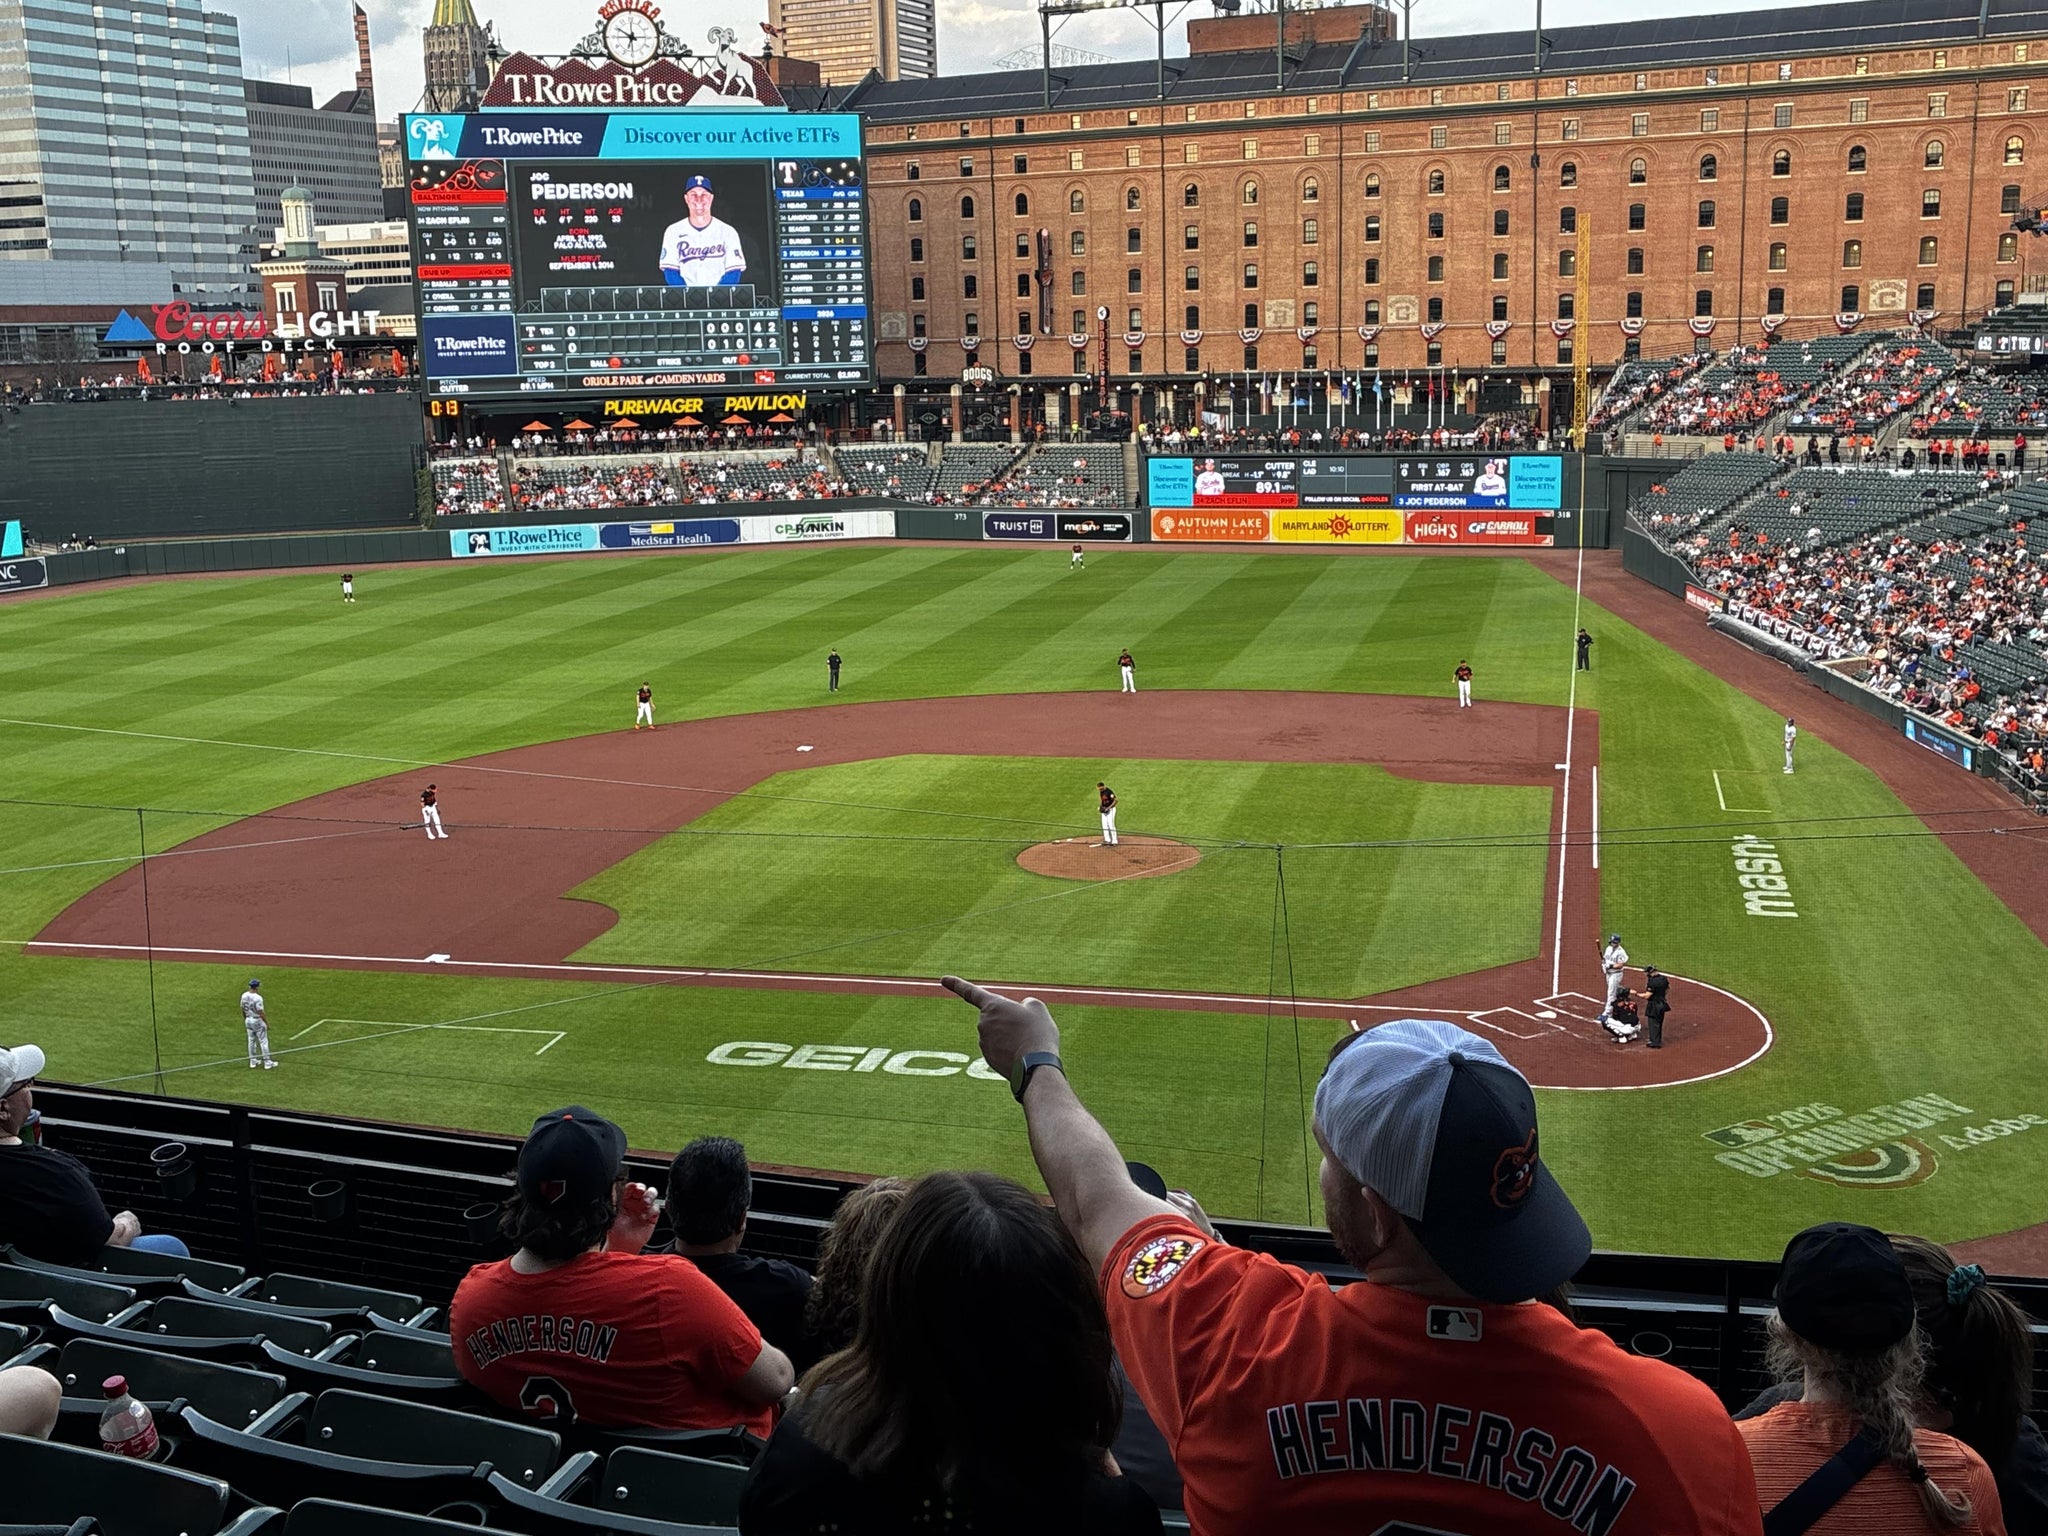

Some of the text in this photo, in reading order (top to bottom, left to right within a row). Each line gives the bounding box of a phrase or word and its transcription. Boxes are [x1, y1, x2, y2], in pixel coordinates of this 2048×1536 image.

[624, 126, 840, 144] Discover our Active ETFs
[530, 172, 550, 182] JOC
[417, 193, 462, 201] BALTIMORE
[531, 183, 633, 200] PEDERSON
[781, 190, 805, 198] TEXAS
[151, 300, 381, 341] Coors LIGHT
[156, 338, 337, 355] ROOF DECK
[582, 373, 726, 387] ORIOLE PARK CAMDEN YARDS
[431, 400, 459, 417] 0:13
[604, 394, 807, 416] PUREWAGER PAVILION
[1265, 462, 1296, 470] CUTTER
[1256, 481, 1280, 494] 89.1
[1411, 483, 1464, 492] FIRST AT-BAT
[1405, 497, 1422, 506] JOC
[1423, 497, 1467, 506] PEDERSON
[953, 513, 968, 521] 373
[1557, 510, 1571, 519] 318
[993, 521, 1028, 531] TRUIST
[1178, 517, 1263, 528] AUTUMN LAKE
[1282, 521, 1330, 531] MARYLAND
[1486, 521, 1530, 531] CARROLL
[1414, 523, 1458, 539] HIGH'S
[631, 533, 712, 547] MedStar Health
[1766, 1102, 1845, 1130] 2026
[1714, 1092, 1975, 1178] OPENING DAY
[1937, 1113, 2048, 1151] Adobe
[1126, 1237, 1168, 1279] ORIOLES
[465, 1314, 618, 1370] HENDERSON
[1266, 1398, 1637, 1536] HENDERSON
